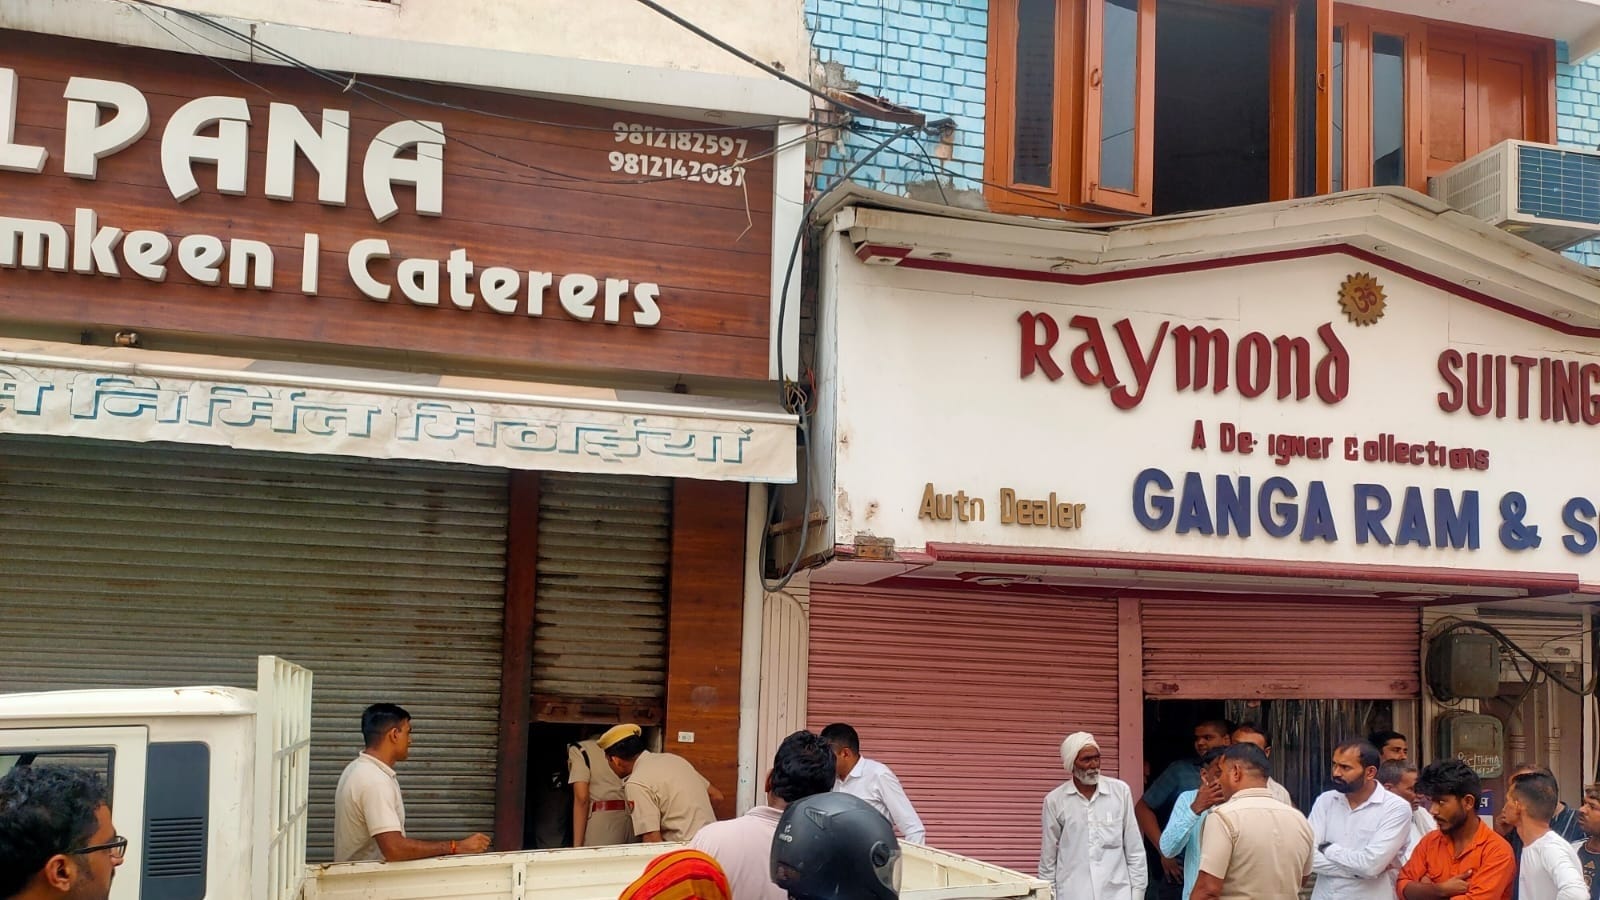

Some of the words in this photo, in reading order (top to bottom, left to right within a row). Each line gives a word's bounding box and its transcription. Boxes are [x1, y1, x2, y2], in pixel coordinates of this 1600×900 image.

[612, 122, 749, 159] 9812182597
[608, 151, 746, 187] 9812142087
[347, 238, 662, 328] Caterers
[1017, 310, 1350, 410] Raymond
[1437, 349, 1600, 425] SUITING
[1191, 420, 1206, 449] A
[1000, 487, 1086, 528] Dealer
[1133, 468, 1338, 541] GANGA
[1353, 483, 1480, 550] RAM
[1499, 491, 1542, 551] &
